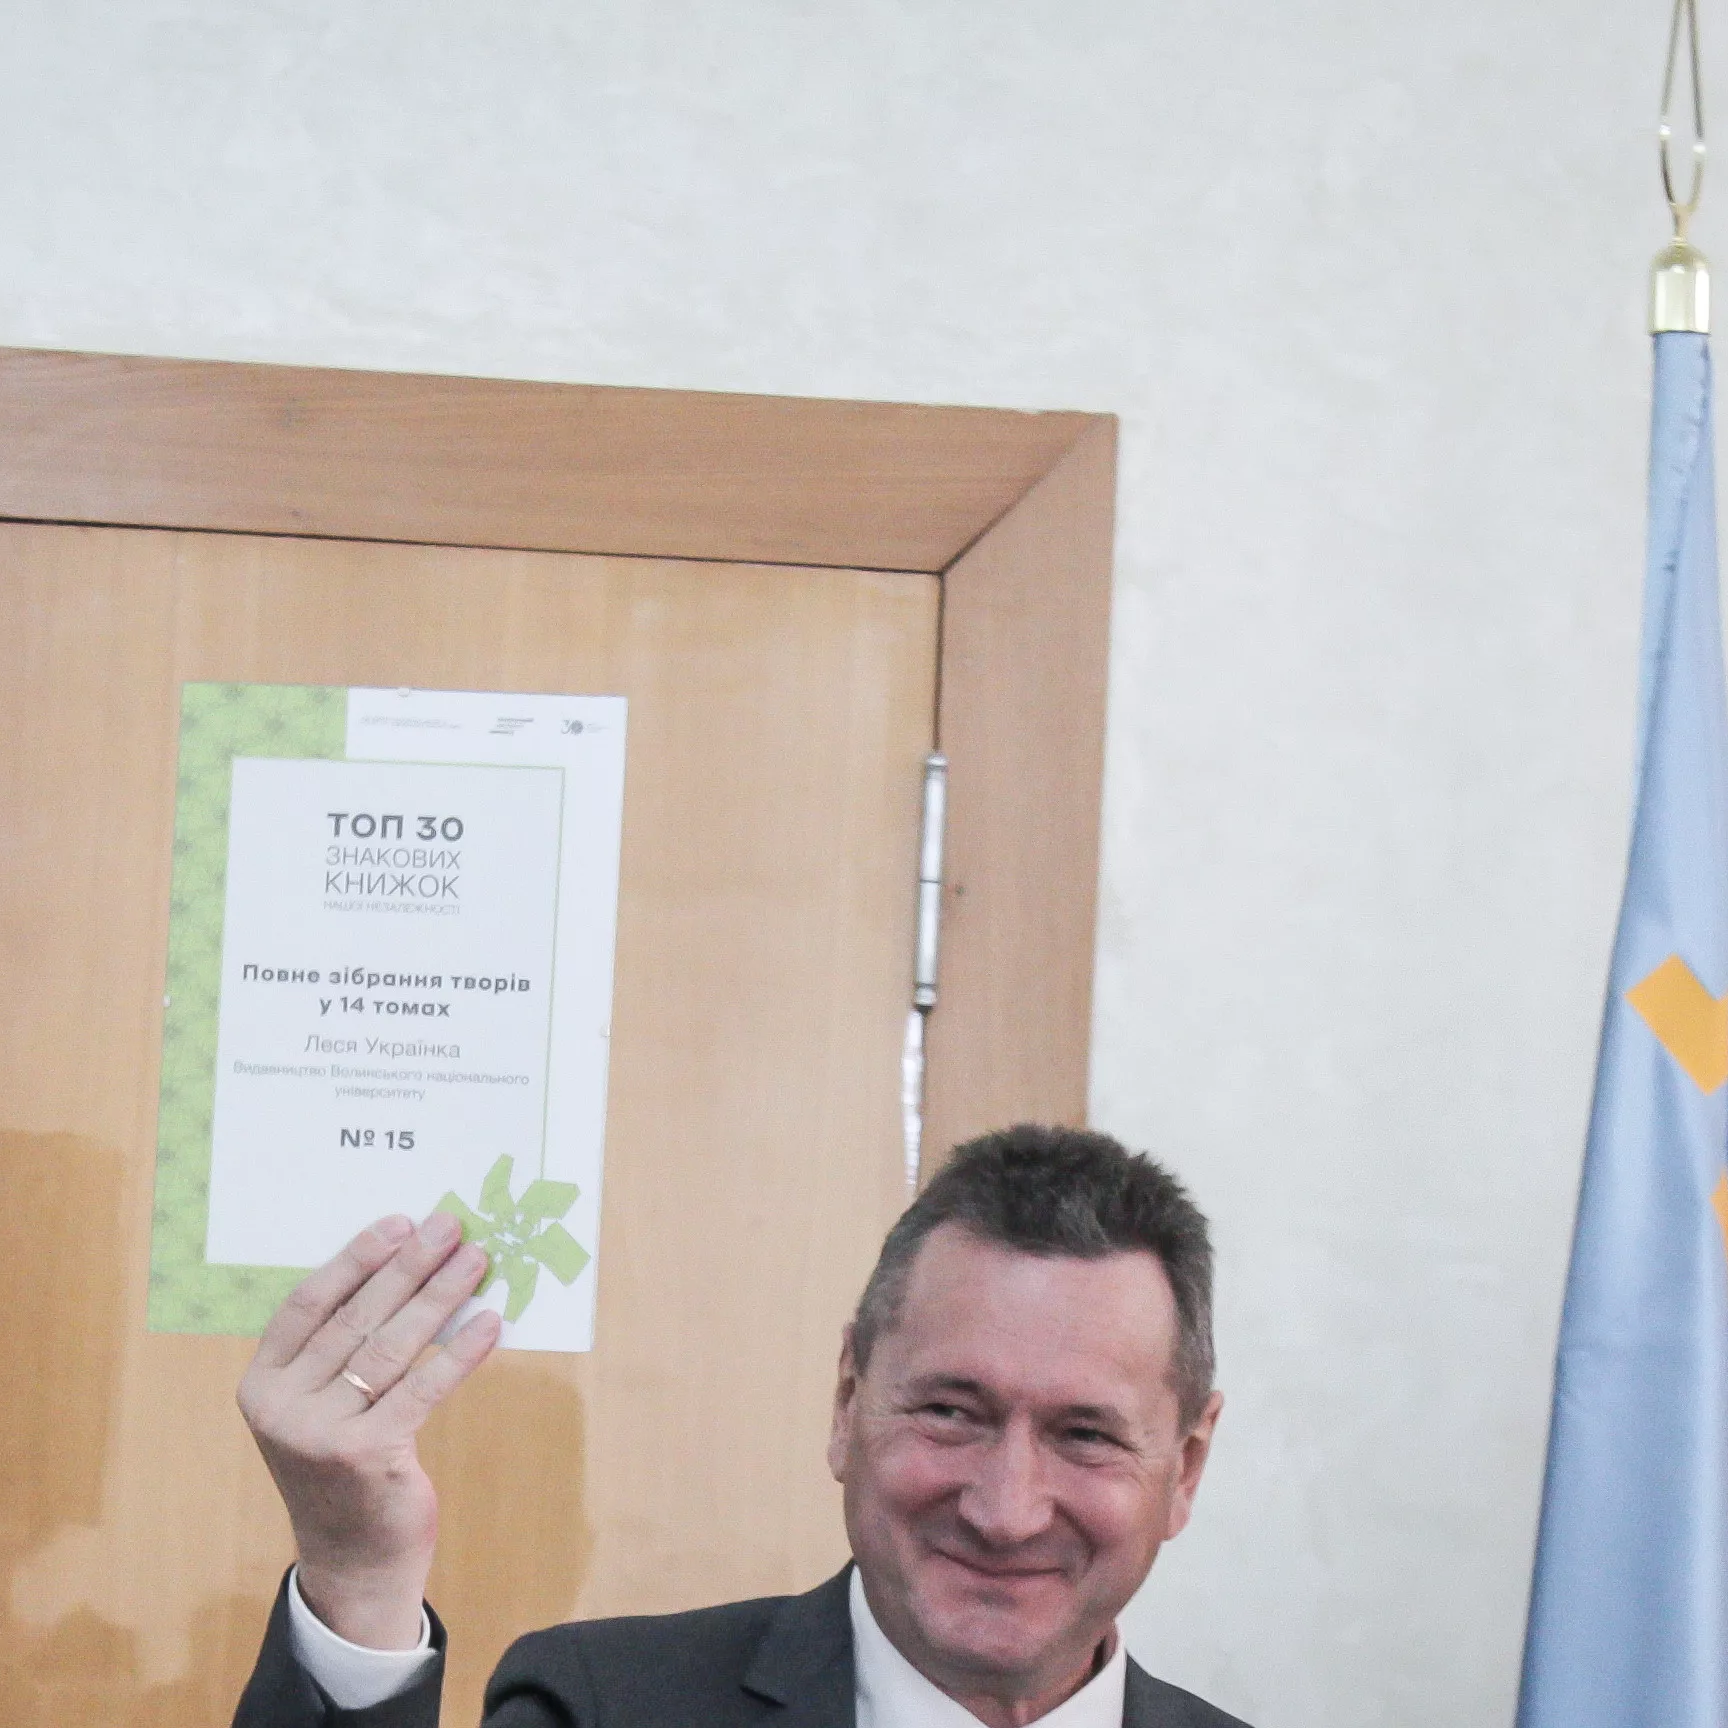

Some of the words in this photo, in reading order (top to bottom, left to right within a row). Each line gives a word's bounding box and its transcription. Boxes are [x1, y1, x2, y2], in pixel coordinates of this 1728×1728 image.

[326, 812, 404, 839] ТОП
[416, 815, 464, 842] 30
[325, 845, 461, 870] ЗНАКОВИХ
[325, 870, 460, 899] КНИЖОК
[242, 964, 320, 983] Повне
[328, 966, 443, 989] зібрання
[450, 972, 531, 995] творів
[319, 996, 332, 1016] у
[339, 996, 365, 1013] 14
[373, 1000, 451, 1017] томах
[304, 1034, 358, 1053] Леся
[365, 1037, 461, 1060] Українка
[384, 1130, 416, 1150] 15
